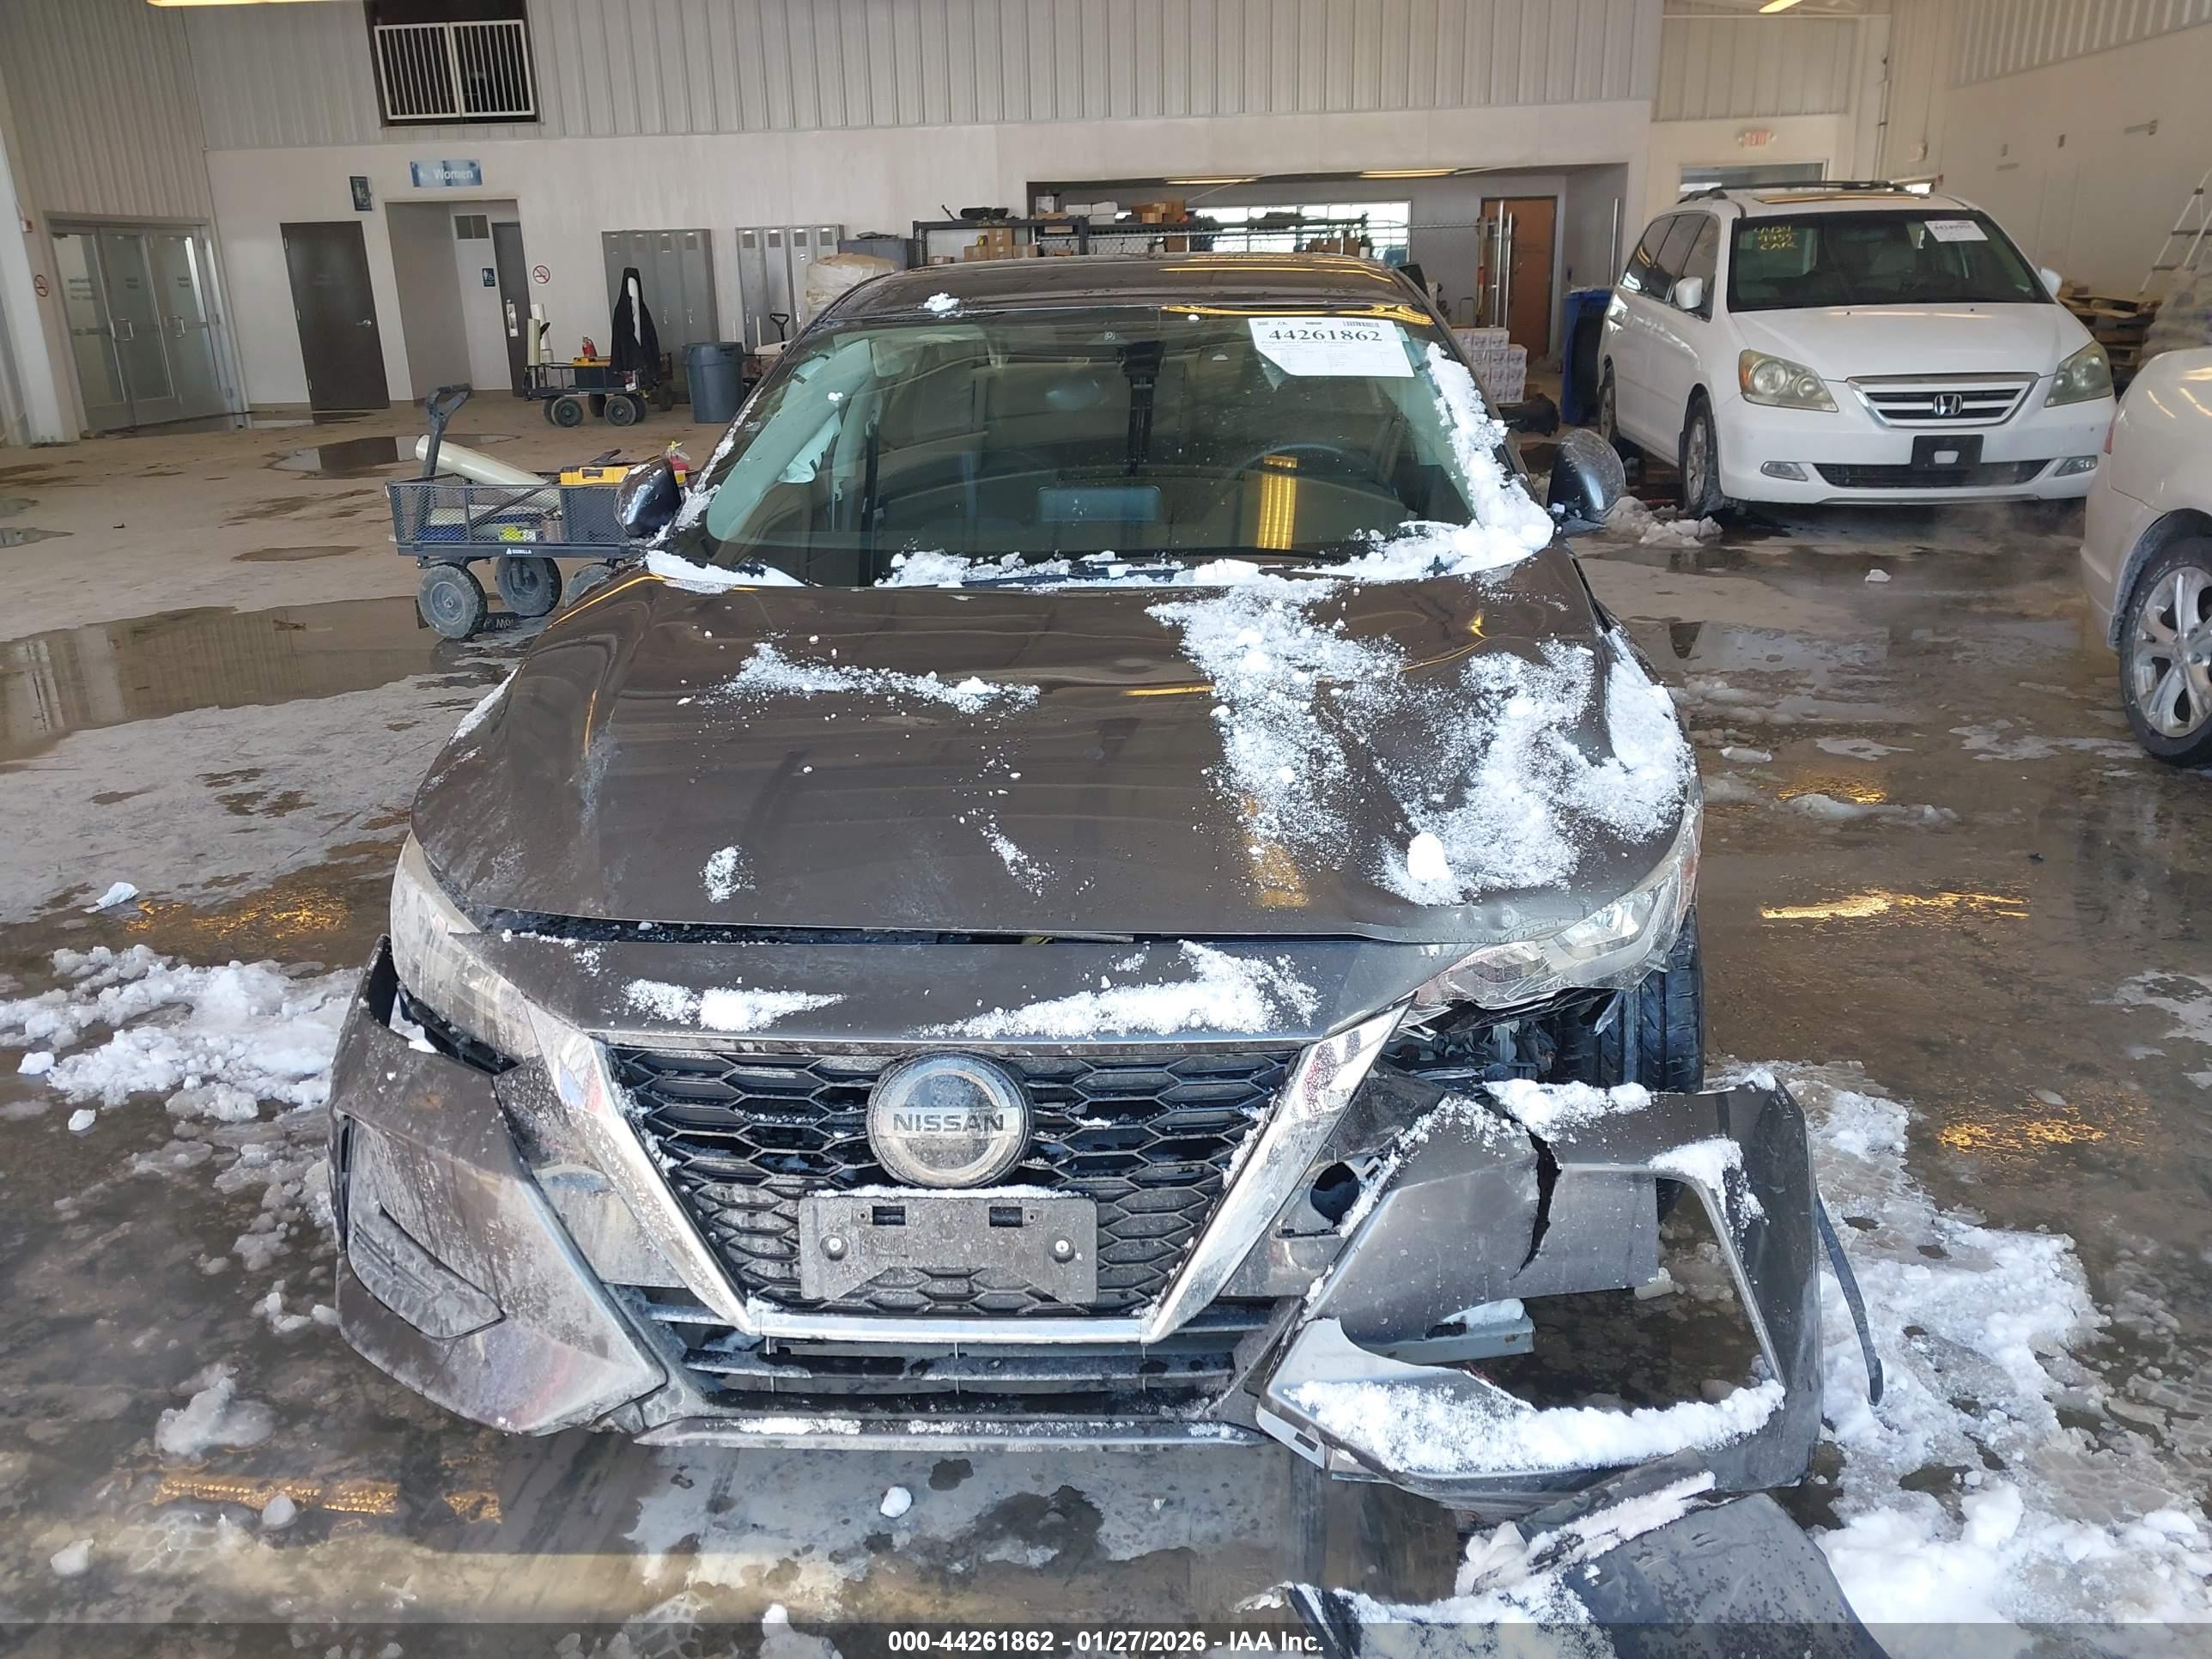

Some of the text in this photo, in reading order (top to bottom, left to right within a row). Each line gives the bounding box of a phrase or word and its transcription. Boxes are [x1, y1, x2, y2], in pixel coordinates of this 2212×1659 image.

[433, 168, 474, 179] Women
[1268, 330, 1382, 341] 44261862
[893, 1113, 1004, 1132] NISSAN
